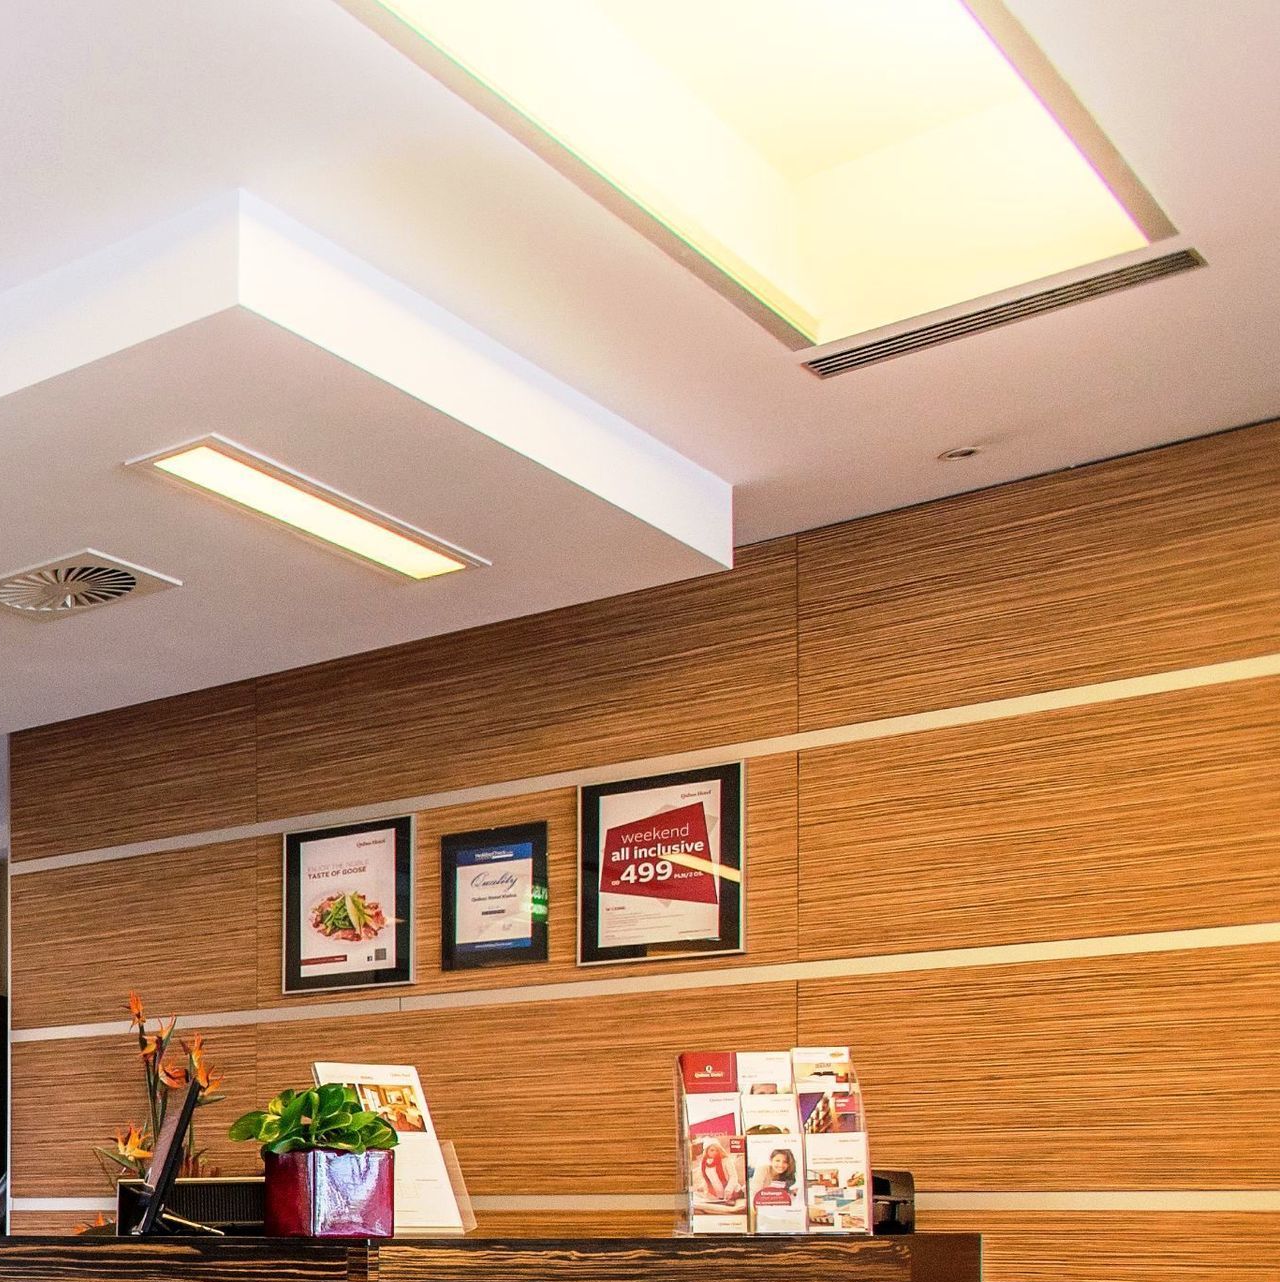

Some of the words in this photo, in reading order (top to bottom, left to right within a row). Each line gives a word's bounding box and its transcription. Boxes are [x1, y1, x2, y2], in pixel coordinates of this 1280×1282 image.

[620, 822, 690, 844] weekend
[611, 847, 630, 862] all
[633, 840, 705, 860] inclusive
[307, 871, 330, 880] TASTE
[330, 869, 342, 877] OF
[342, 866, 367, 875] GOOSE
[470, 870, 519, 893] Quality
[620, 860, 673, 884] 499
